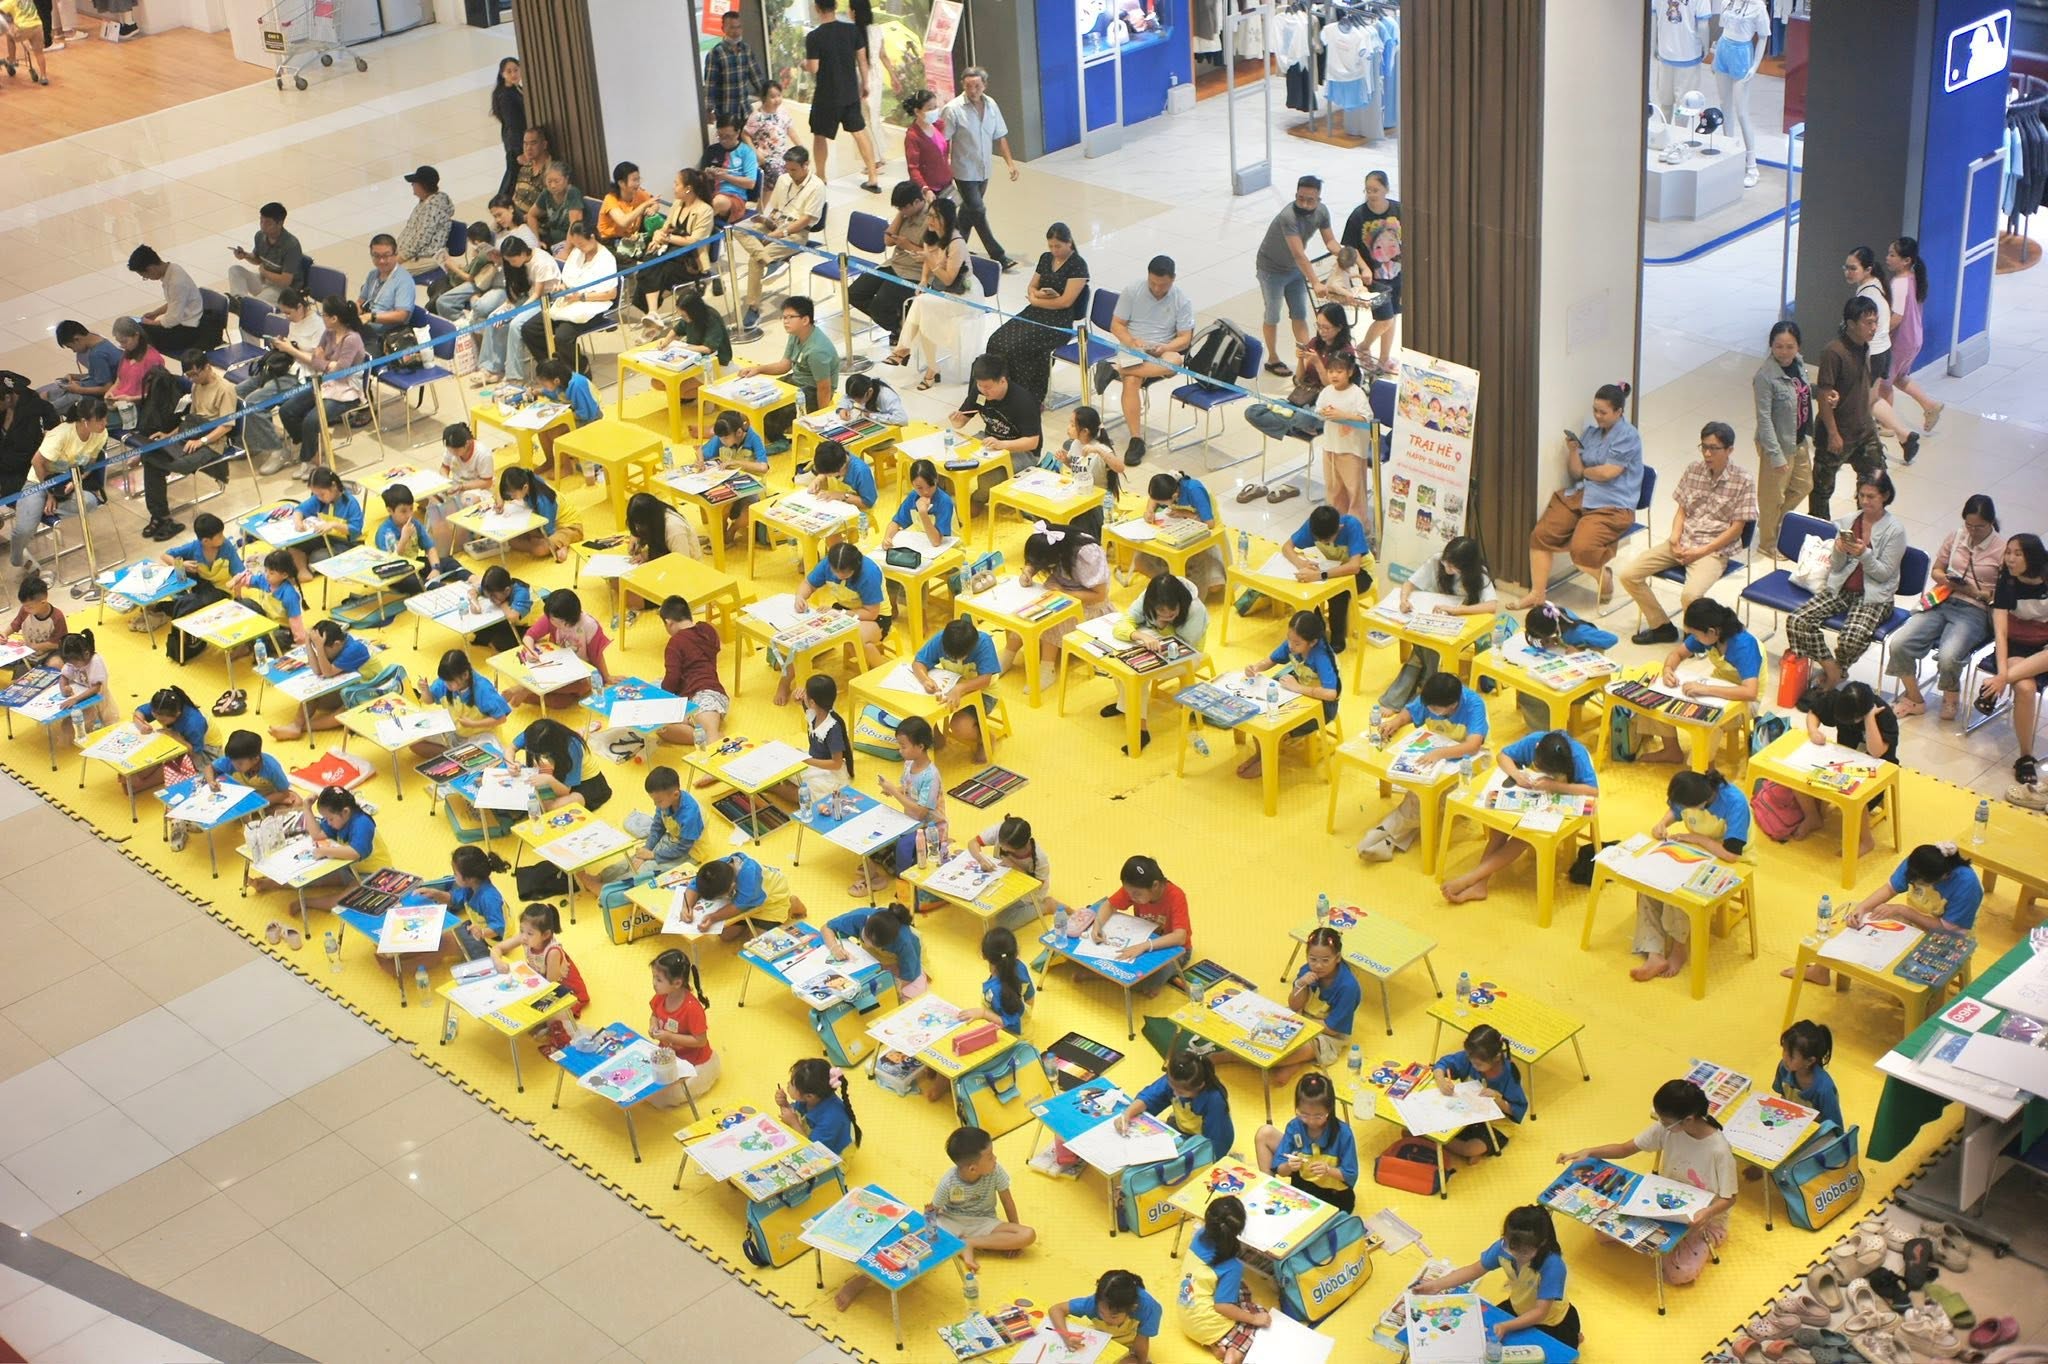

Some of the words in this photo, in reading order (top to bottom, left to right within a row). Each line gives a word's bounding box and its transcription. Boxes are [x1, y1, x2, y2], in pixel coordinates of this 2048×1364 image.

[1407, 450, 1427, 463] HAPPY
[1428, 457, 1456, 473] SUMMER
[1952, 1004, 1978, 1021] 99K
